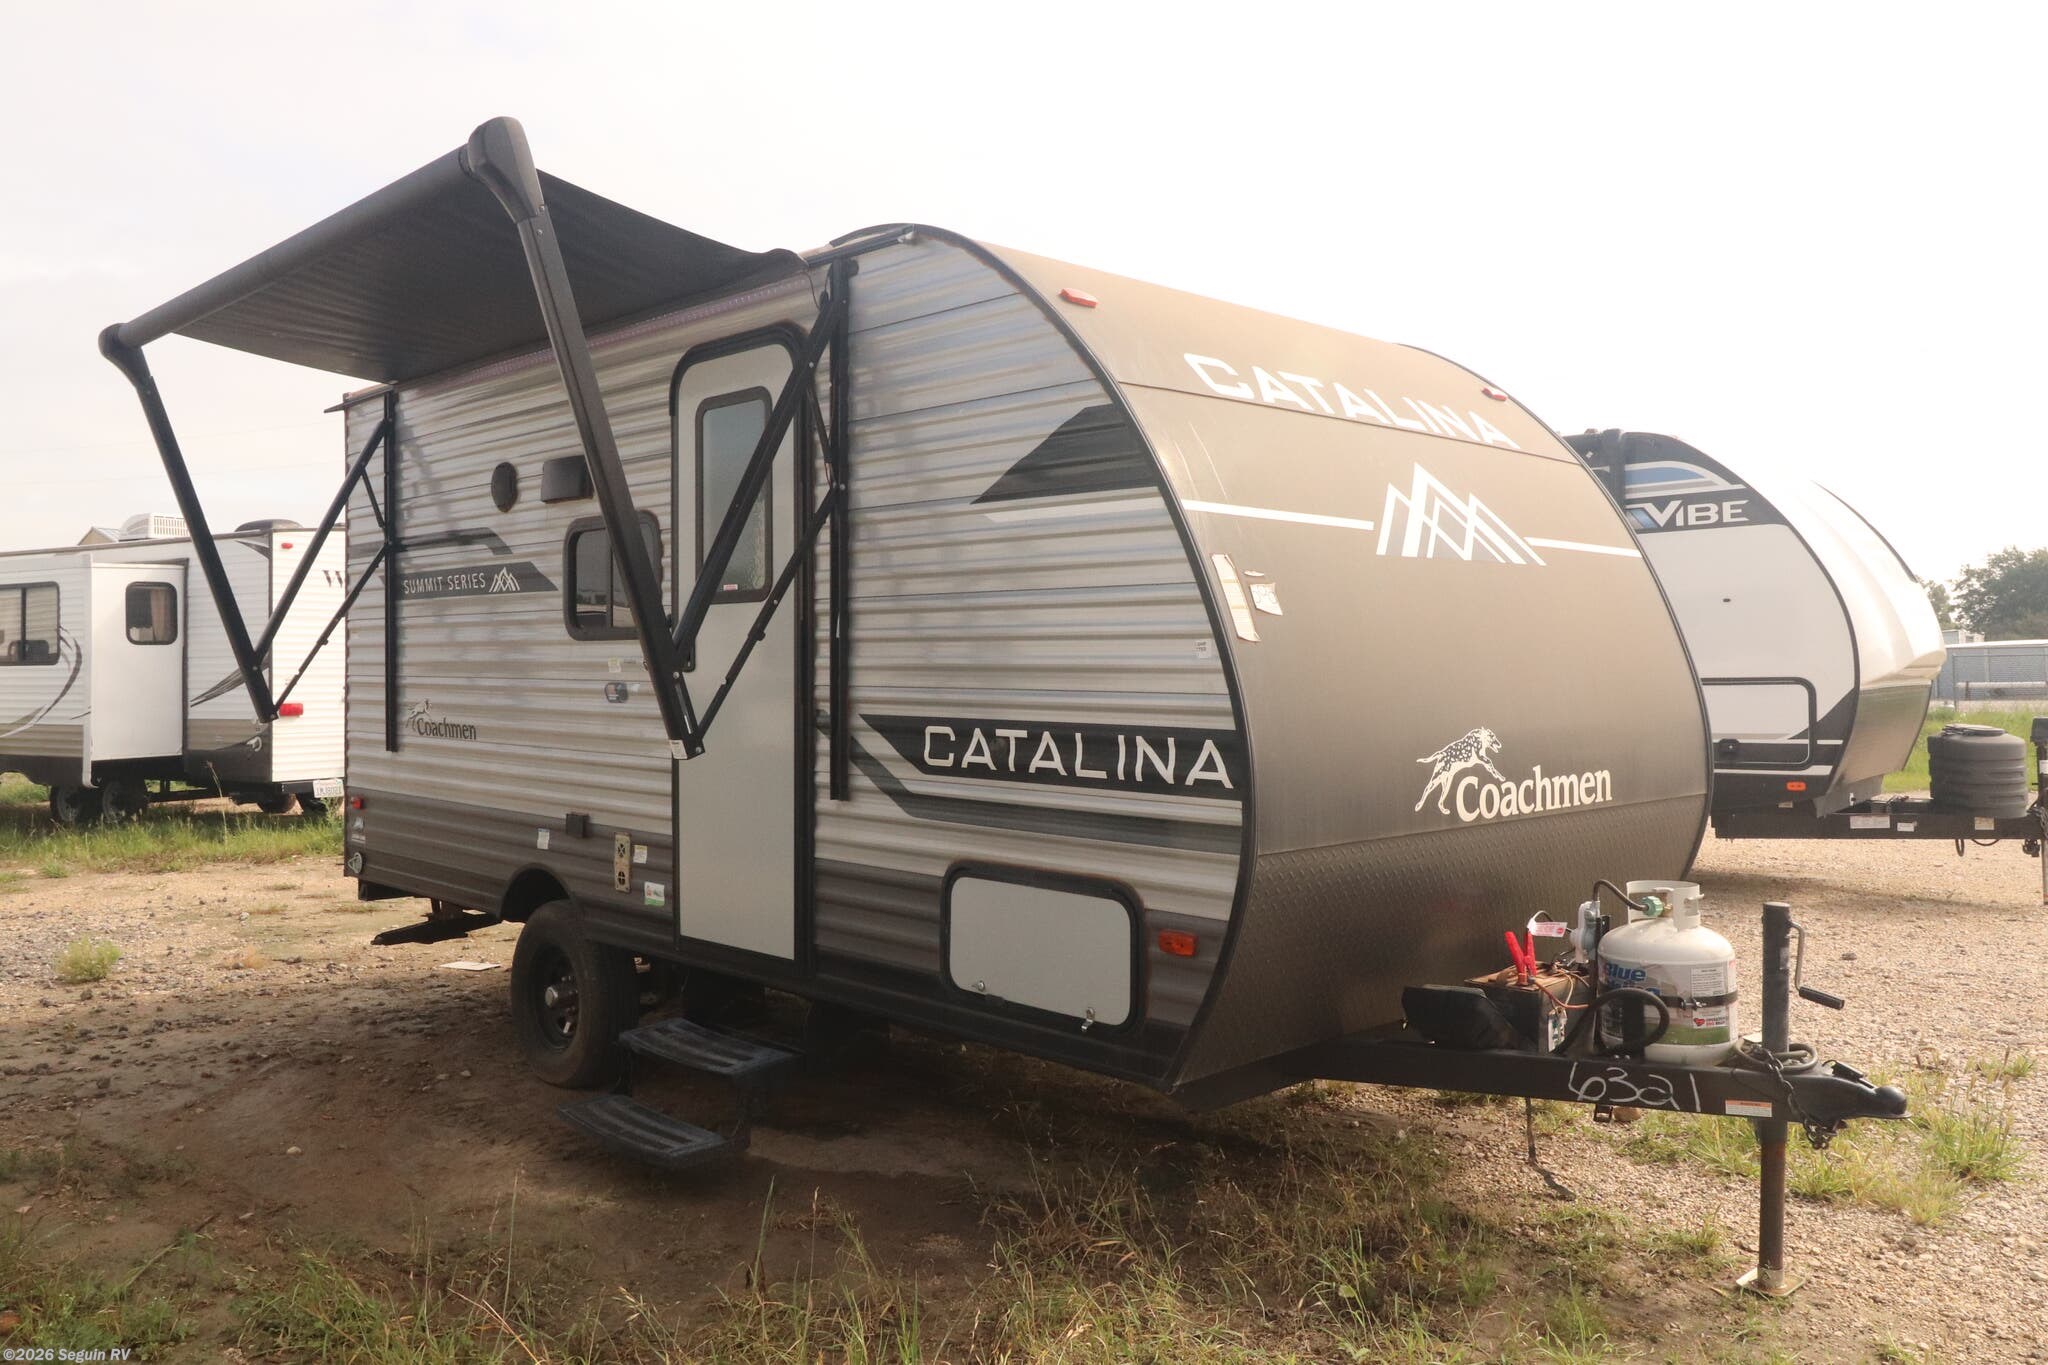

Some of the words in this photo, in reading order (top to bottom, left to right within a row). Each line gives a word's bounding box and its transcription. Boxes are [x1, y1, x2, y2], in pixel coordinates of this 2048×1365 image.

[1183, 352, 1521, 450] CATALINA
[1625, 499, 1749, 528] VIBE
[403, 576, 443, 595] SUMMIT
[447, 572, 486, 591] SERIES
[416, 716, 477, 740] Coachmen
[923, 725, 1235, 790] CATALINA
[1455, 764, 1613, 823] Coachmen
[1567, 1061, 1702, 1113] 6321
